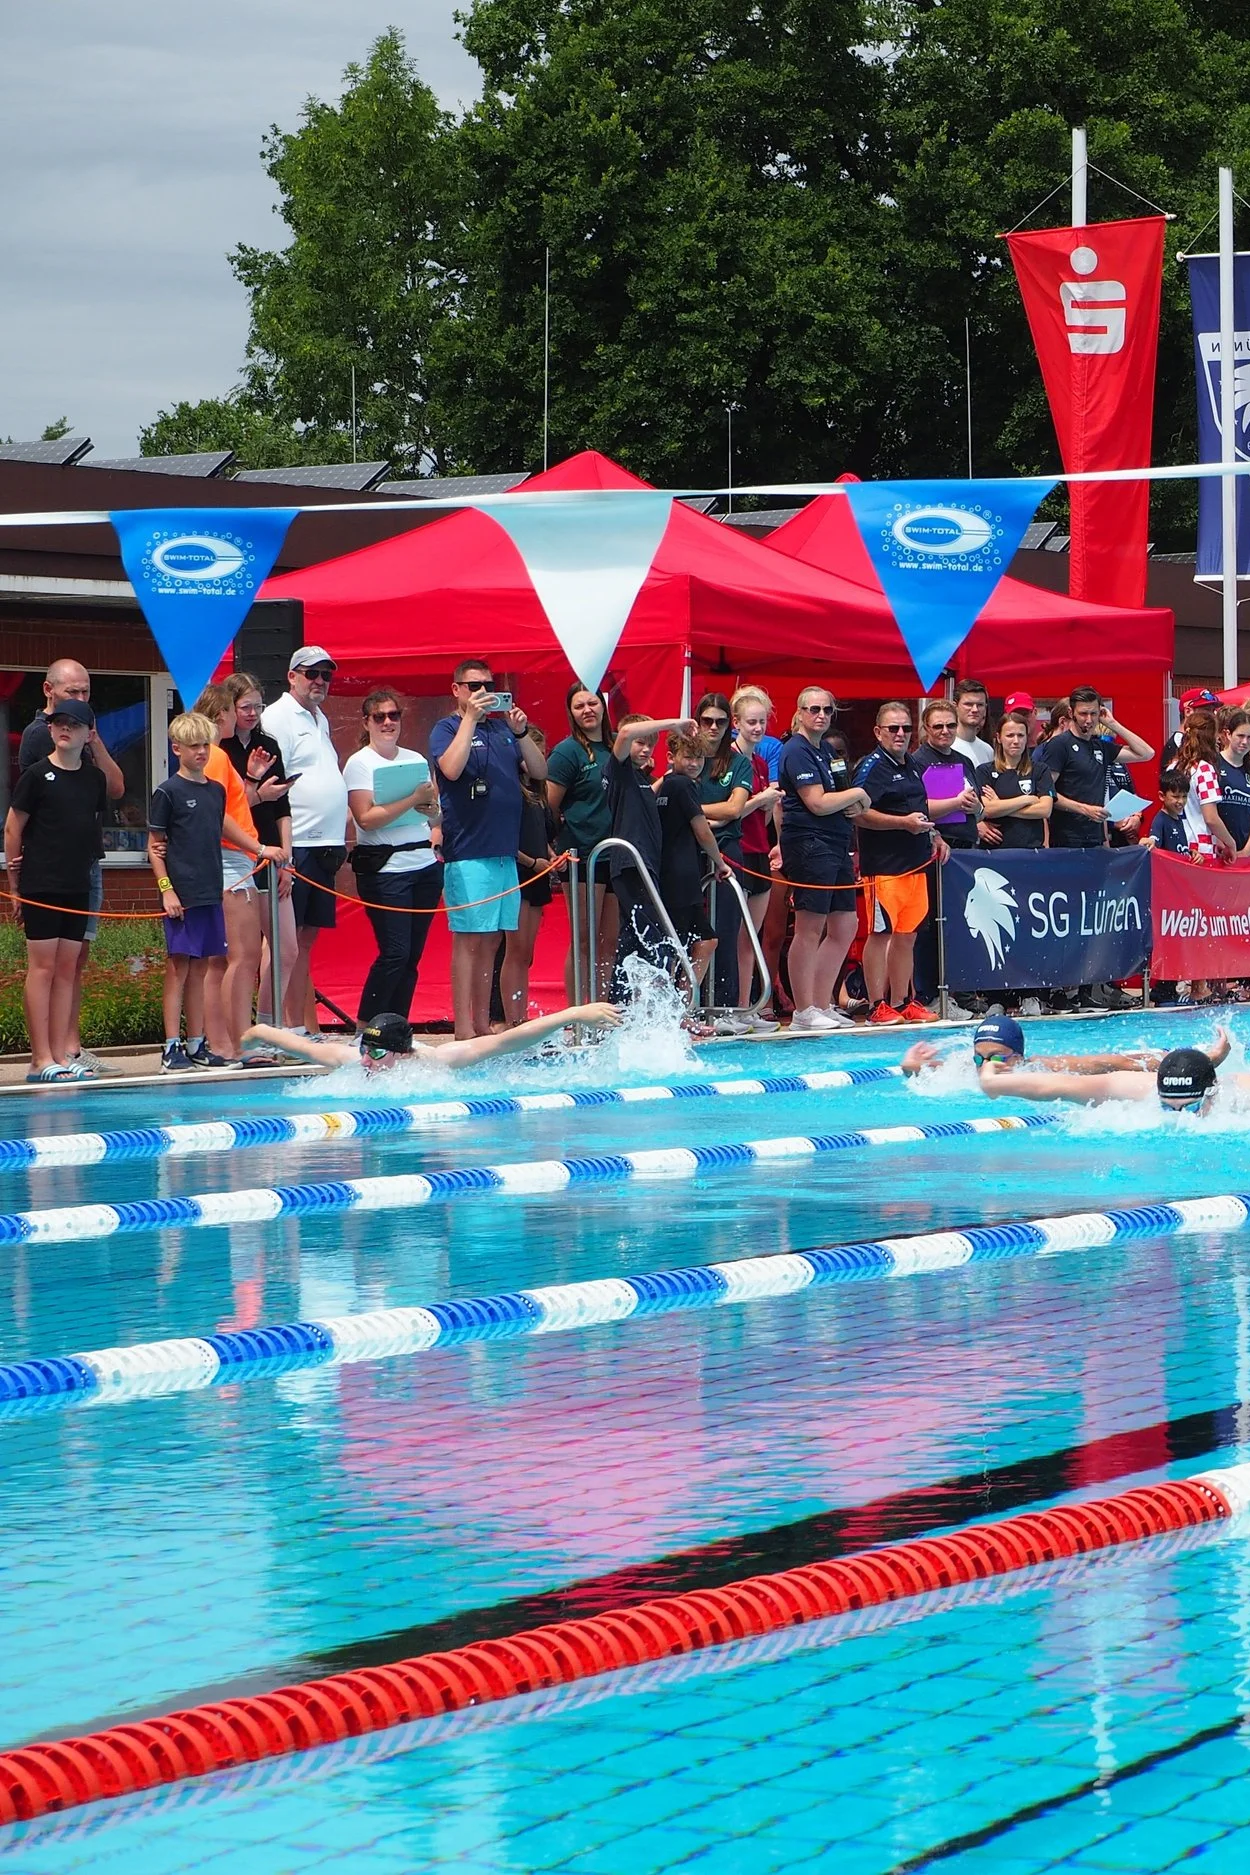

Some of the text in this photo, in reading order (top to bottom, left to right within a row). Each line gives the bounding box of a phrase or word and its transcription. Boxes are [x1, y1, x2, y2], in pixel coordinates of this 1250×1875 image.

[905, 526, 961, 535] SWIM-TOTAL
[163, 554, 216, 562] SWIM-TOTAL
[899, 561, 984, 572] www.swim-total.de
[158, 587, 237, 596] www.swim-total.de
[1028, 890, 1143, 939] SG Lünen
[1160, 908, 1208, 937] Weil's
[1209, 914, 1229, 937] um
[1163, 1076, 1193, 1086] arena
